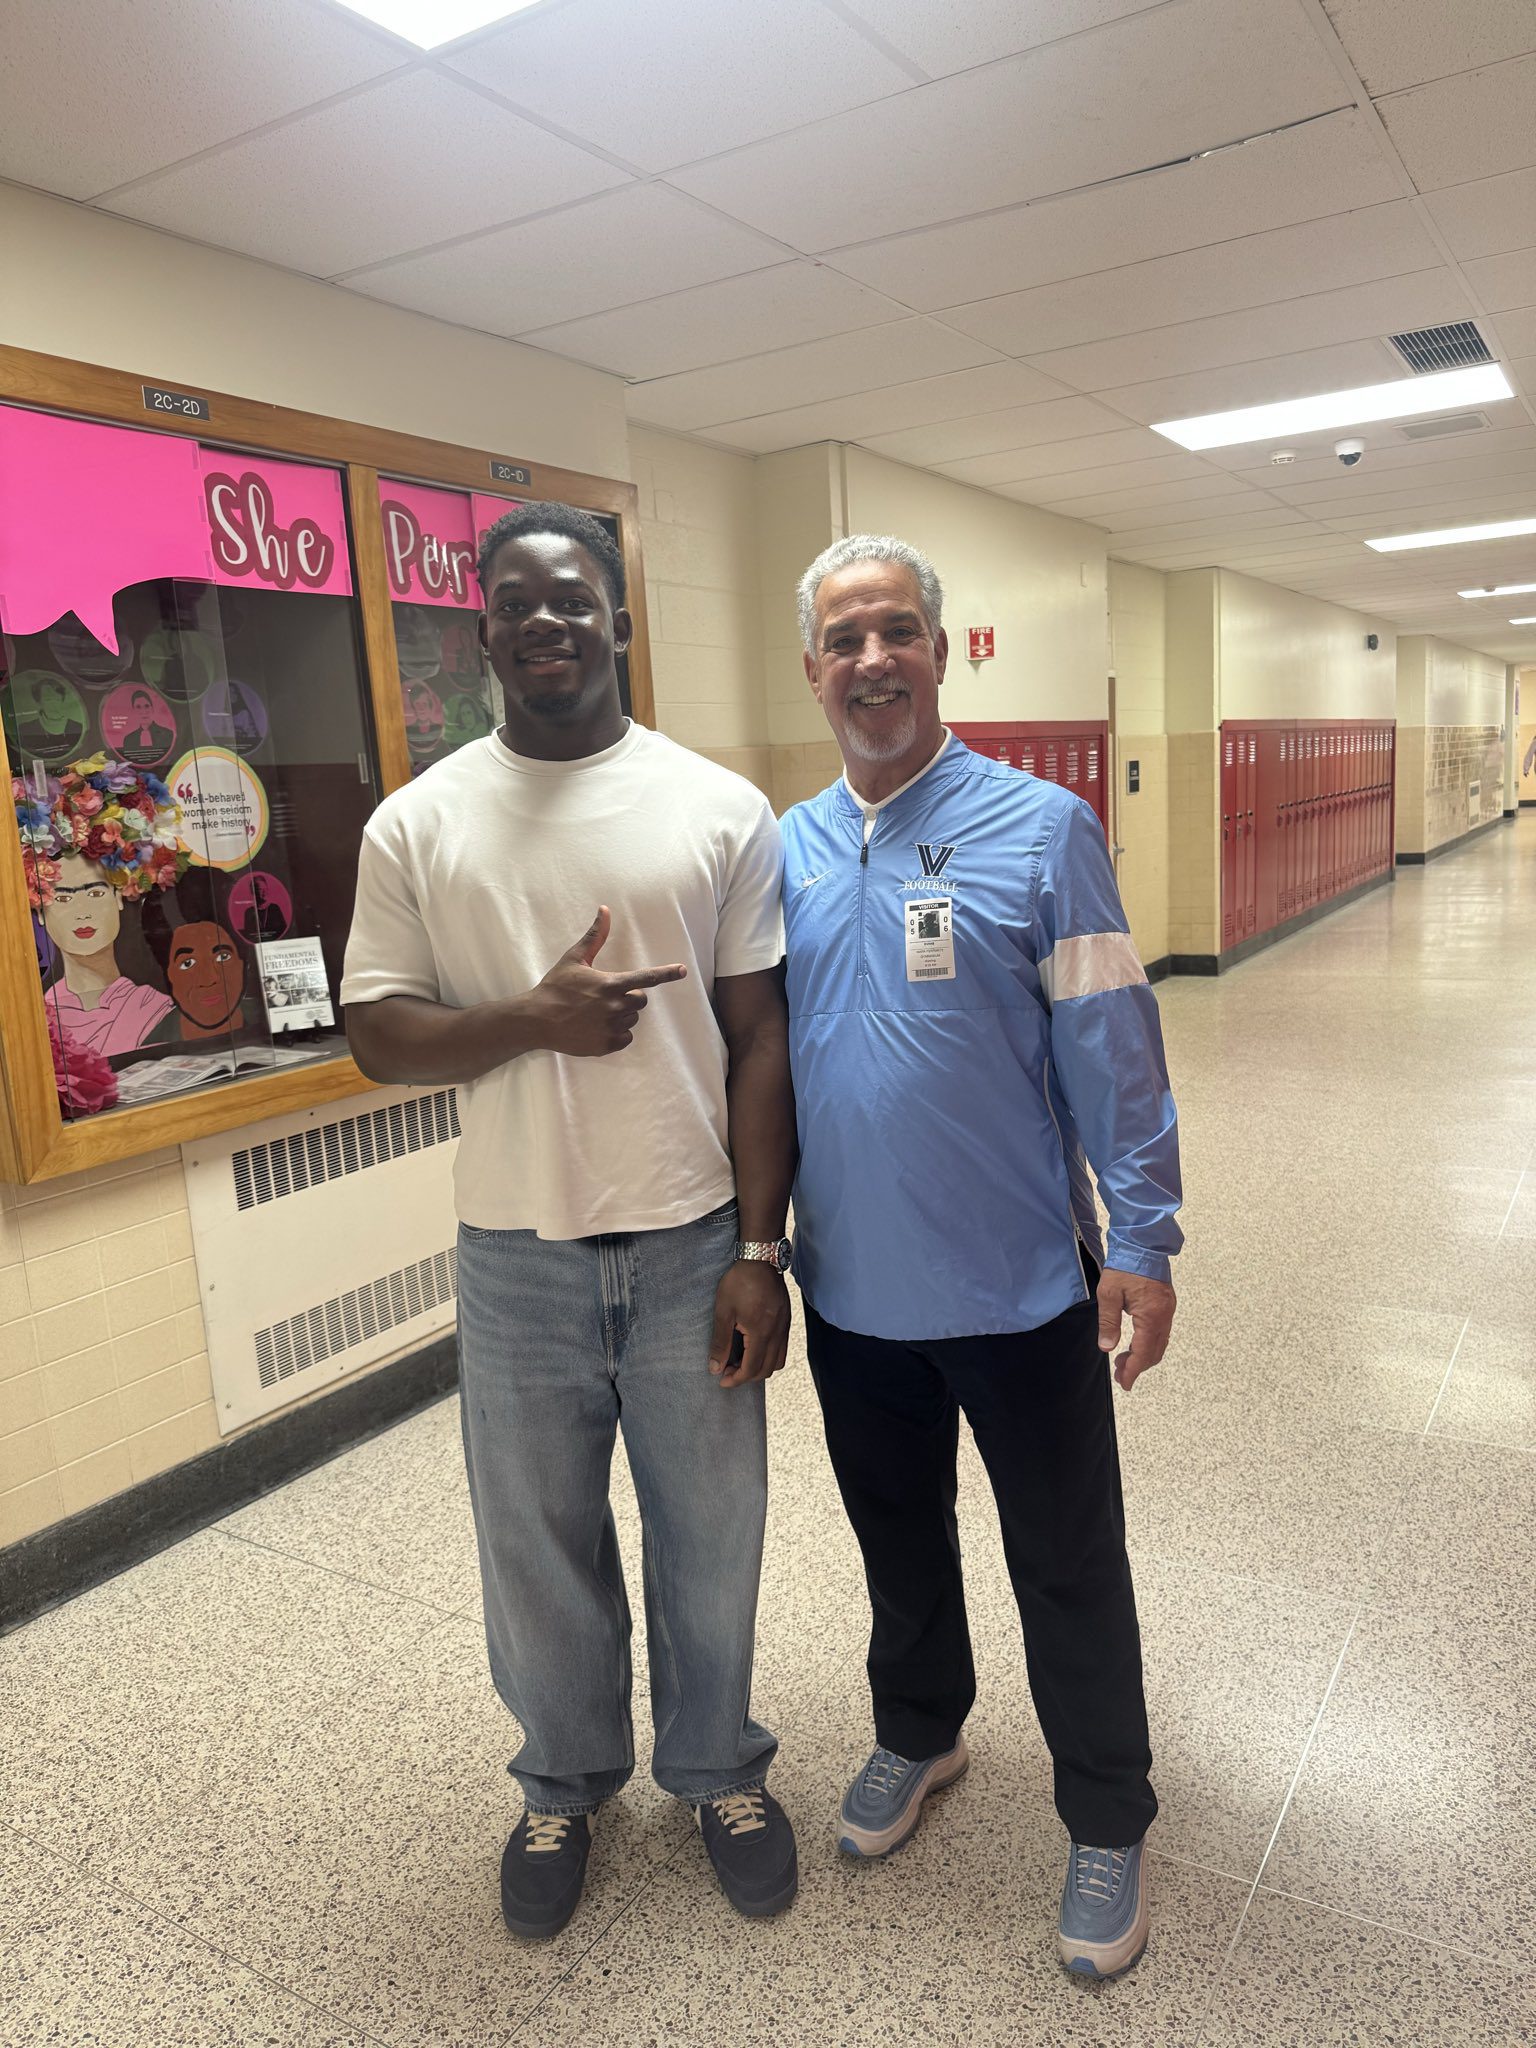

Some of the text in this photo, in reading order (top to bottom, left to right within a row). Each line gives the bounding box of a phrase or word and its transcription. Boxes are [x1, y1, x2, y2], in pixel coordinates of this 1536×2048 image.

[153, 393, 200, 415] 2C-2D
[208, 478, 330, 584] She
[182, 807, 218, 818] women
[191, 818, 219, 830] make
[915, 843, 957, 878] V
[903, 880, 959, 893] FOOTBALL
[264, 950, 318, 961] FUNDAMENTAL
[265, 957, 319, 970] FREEDOMS
